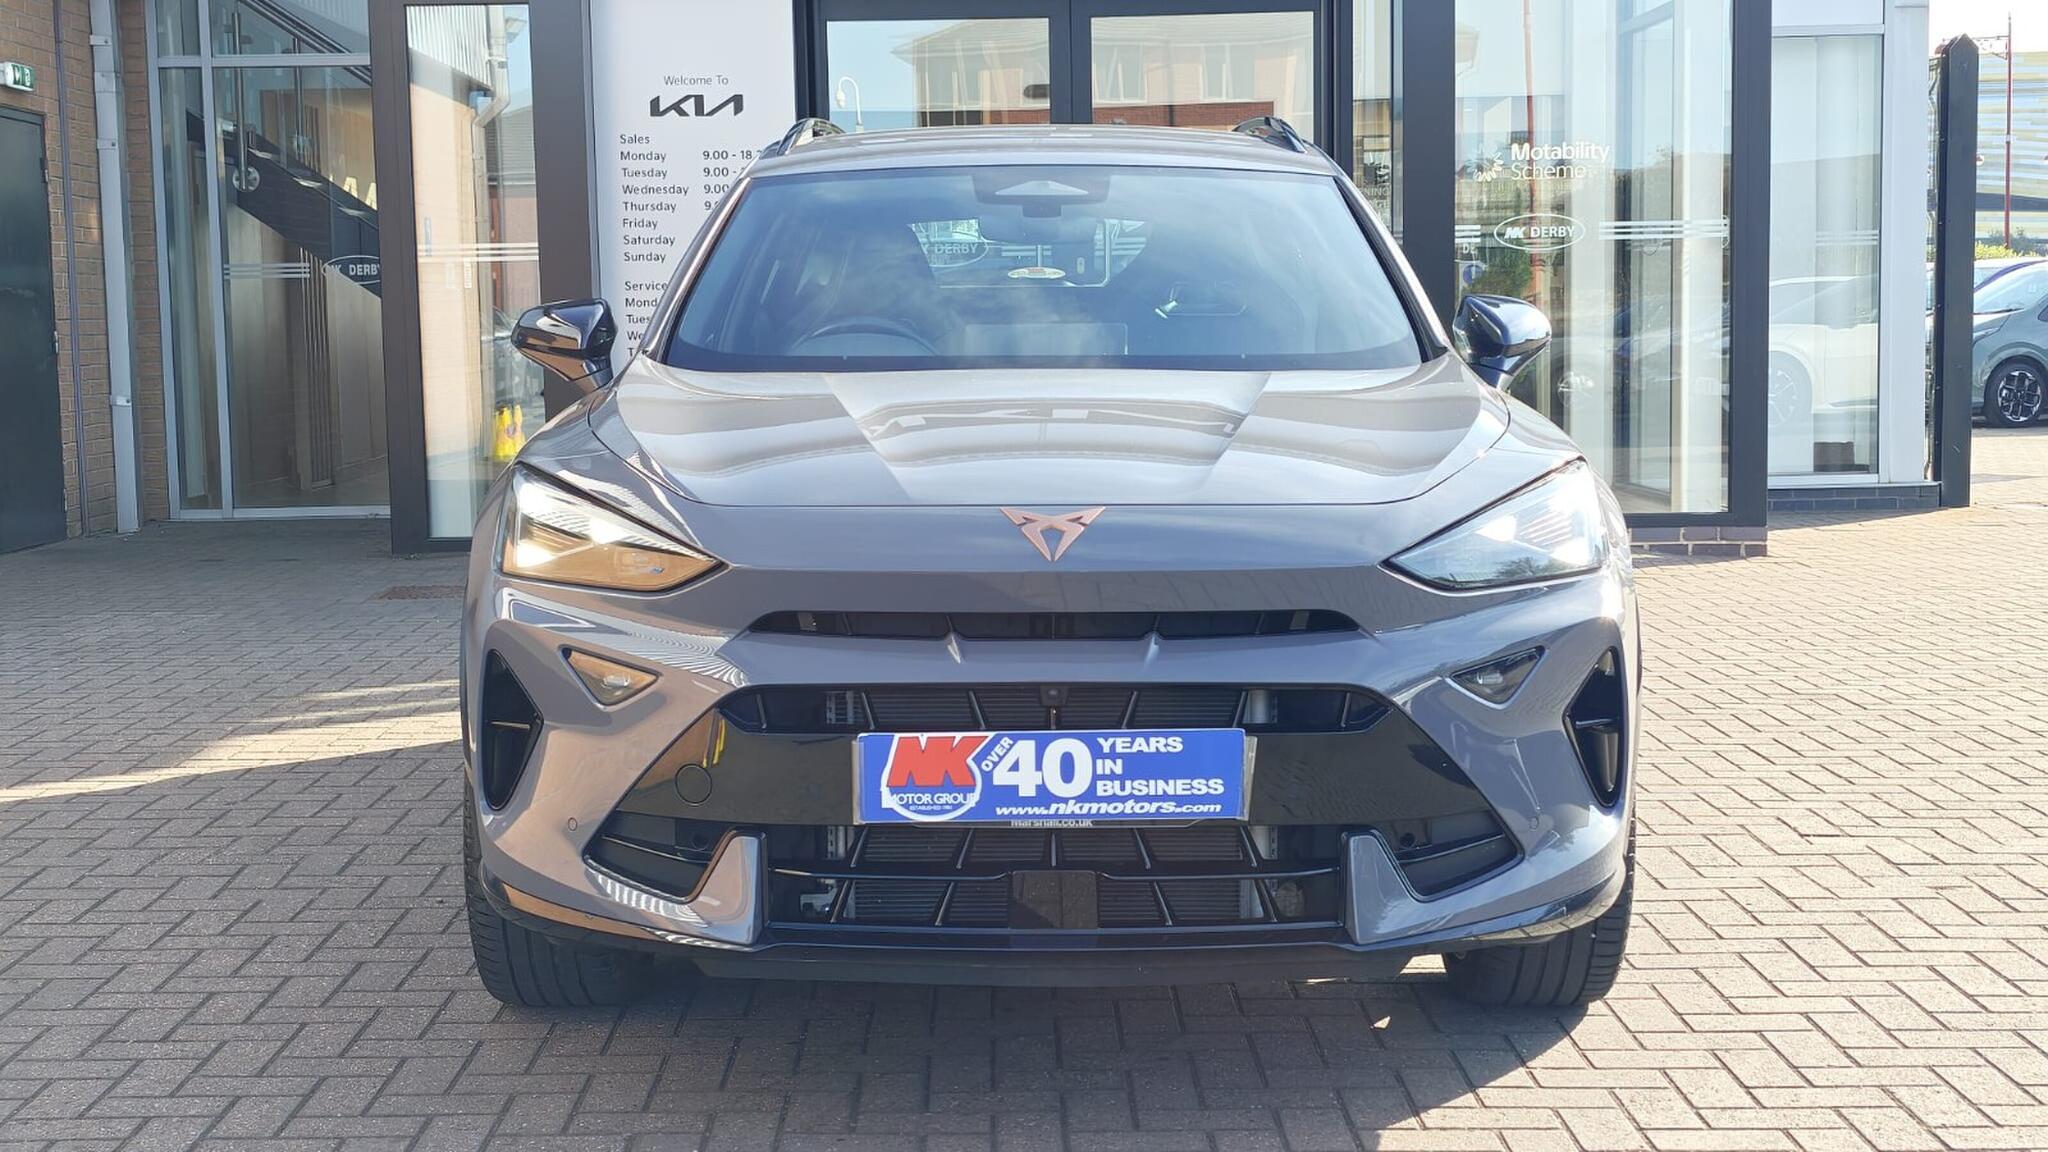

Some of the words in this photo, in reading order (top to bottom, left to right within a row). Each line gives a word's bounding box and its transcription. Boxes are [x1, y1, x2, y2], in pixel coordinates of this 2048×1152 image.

[663, 75, 713, 86] Welcome
[715, 75, 729, 86] To
[619, 134, 650, 144] Sales
[620, 151, 666, 163] Monday
[702, 150, 729, 160] 9.00
[1511, 142, 1611, 162] Motability
[622, 167, 667, 179] Tuesday
[703, 167, 729, 177] 9.00
[1511, 161, 1586, 180] Scheme
[622, 184, 689, 196] Wednesday
[623, 201, 676, 213] Thursday
[622, 218, 657, 230] Friday
[1530, 225, 1575, 238] DERBY
[623, 235, 675, 246] Saturday
[934, 243, 978, 255] DERBY
[624, 252, 666, 264] Sunday
[625, 280, 668, 291] Service
[625, 298, 658, 307] Mond
[626, 314, 650, 324] Tues
[1096, 736, 1184, 753] YEARS
[981, 736, 1014, 772] OVER
[886, 736, 990, 788] NK
[992, 738, 1093, 798] 40
[1096, 758, 1123, 775] IN
[1096, 778, 1225, 796] BUSINESS
[995, 799, 1222, 816] www.nkmotors.com
